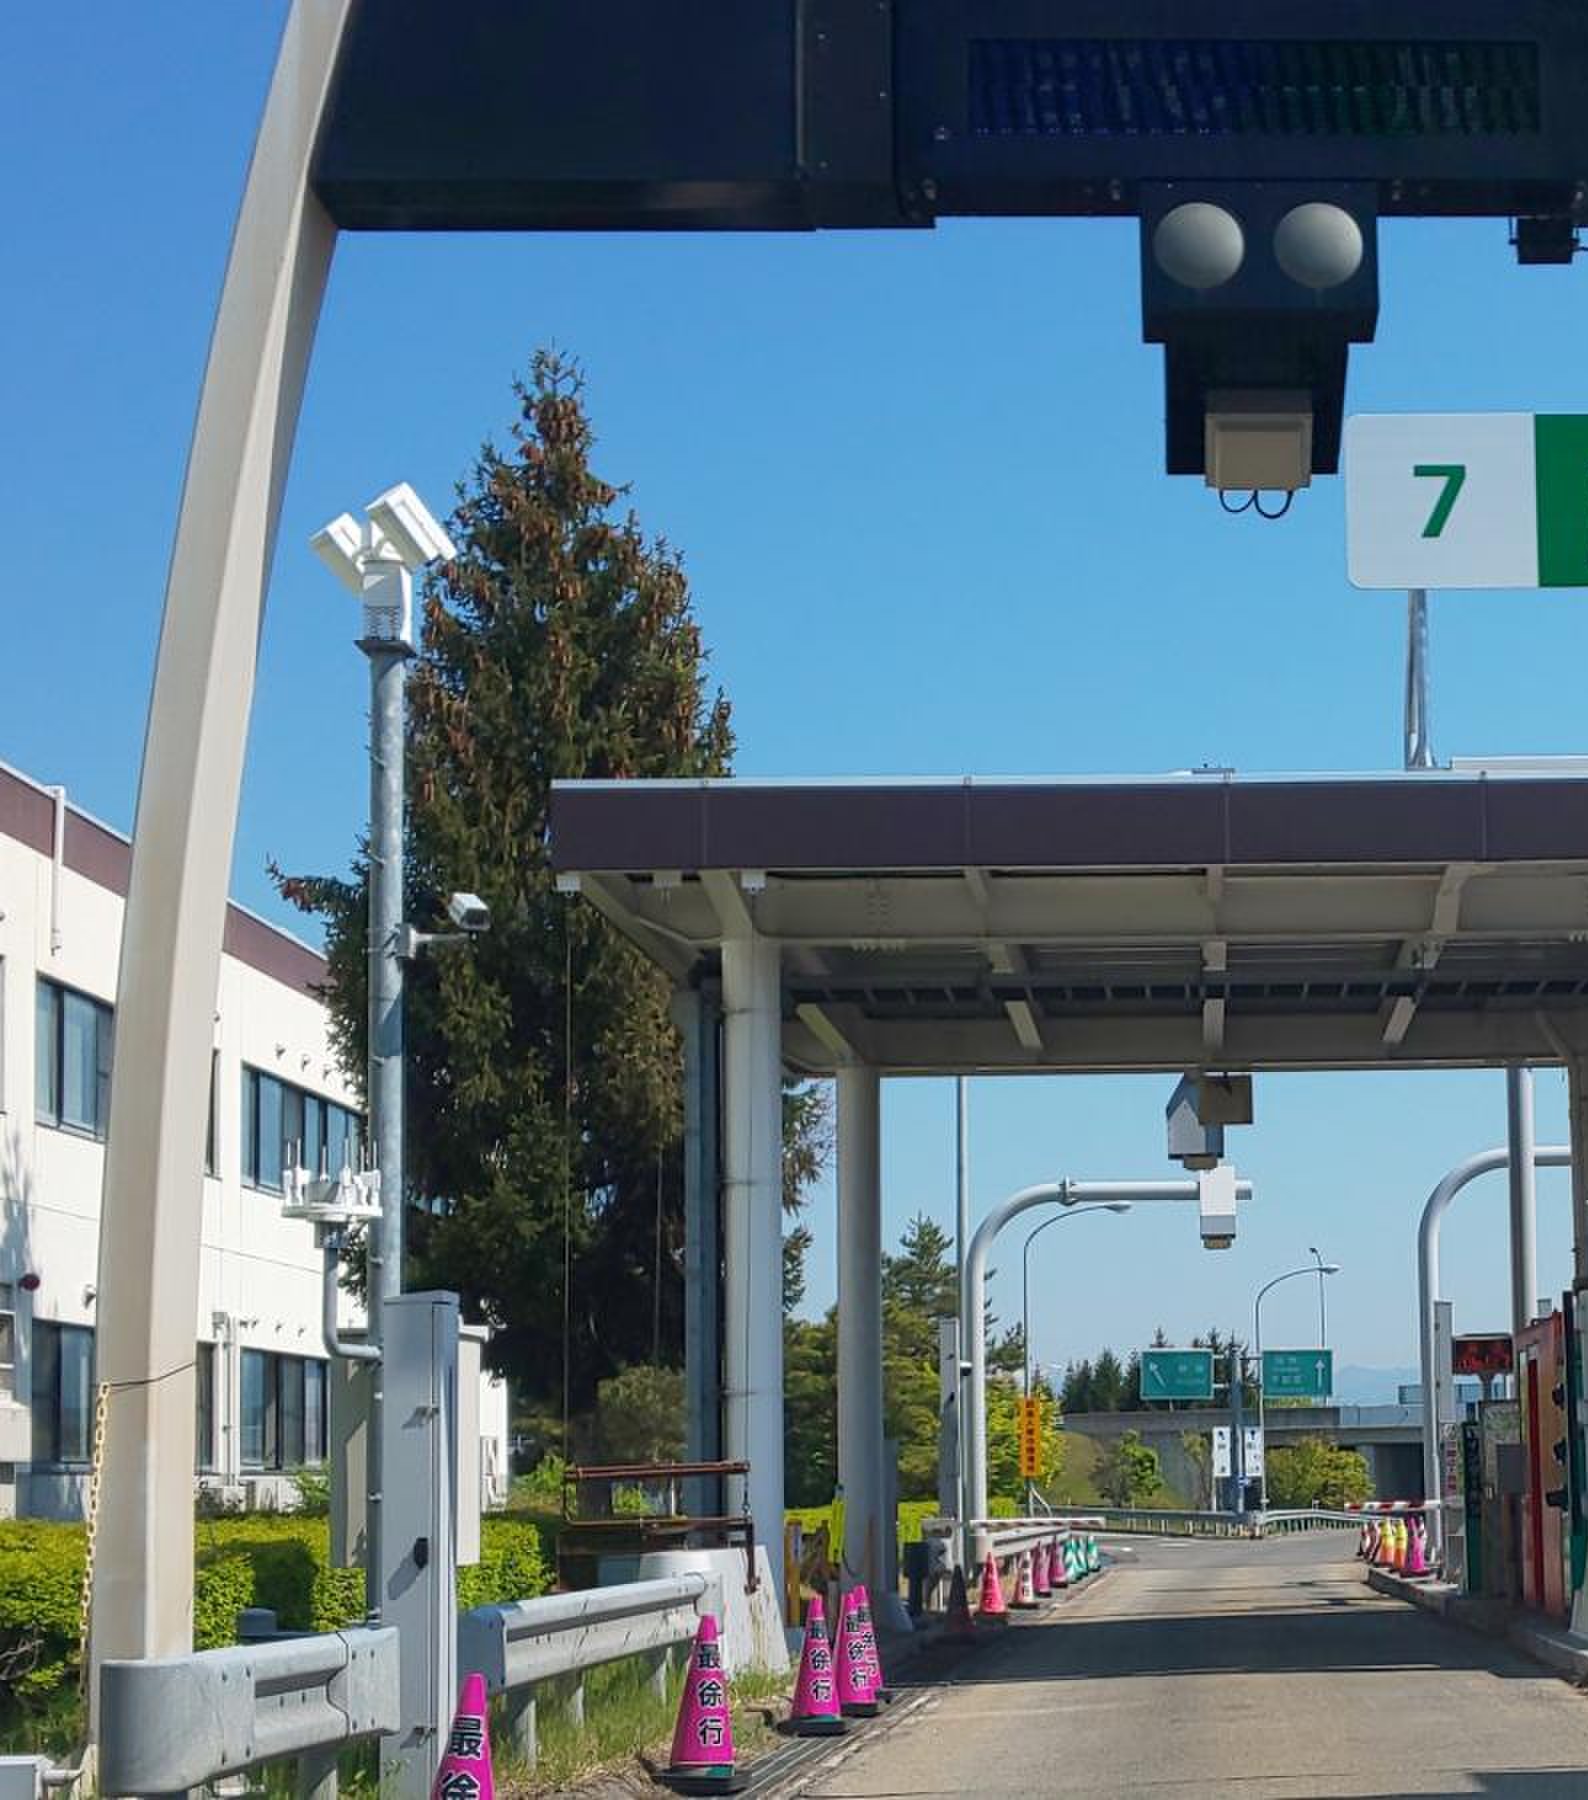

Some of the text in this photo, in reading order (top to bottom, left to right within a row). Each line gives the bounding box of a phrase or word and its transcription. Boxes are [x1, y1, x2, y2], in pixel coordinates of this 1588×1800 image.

[1413, 465, 1466, 538] 7
[697, 1645, 723, 1745] 最徐行
